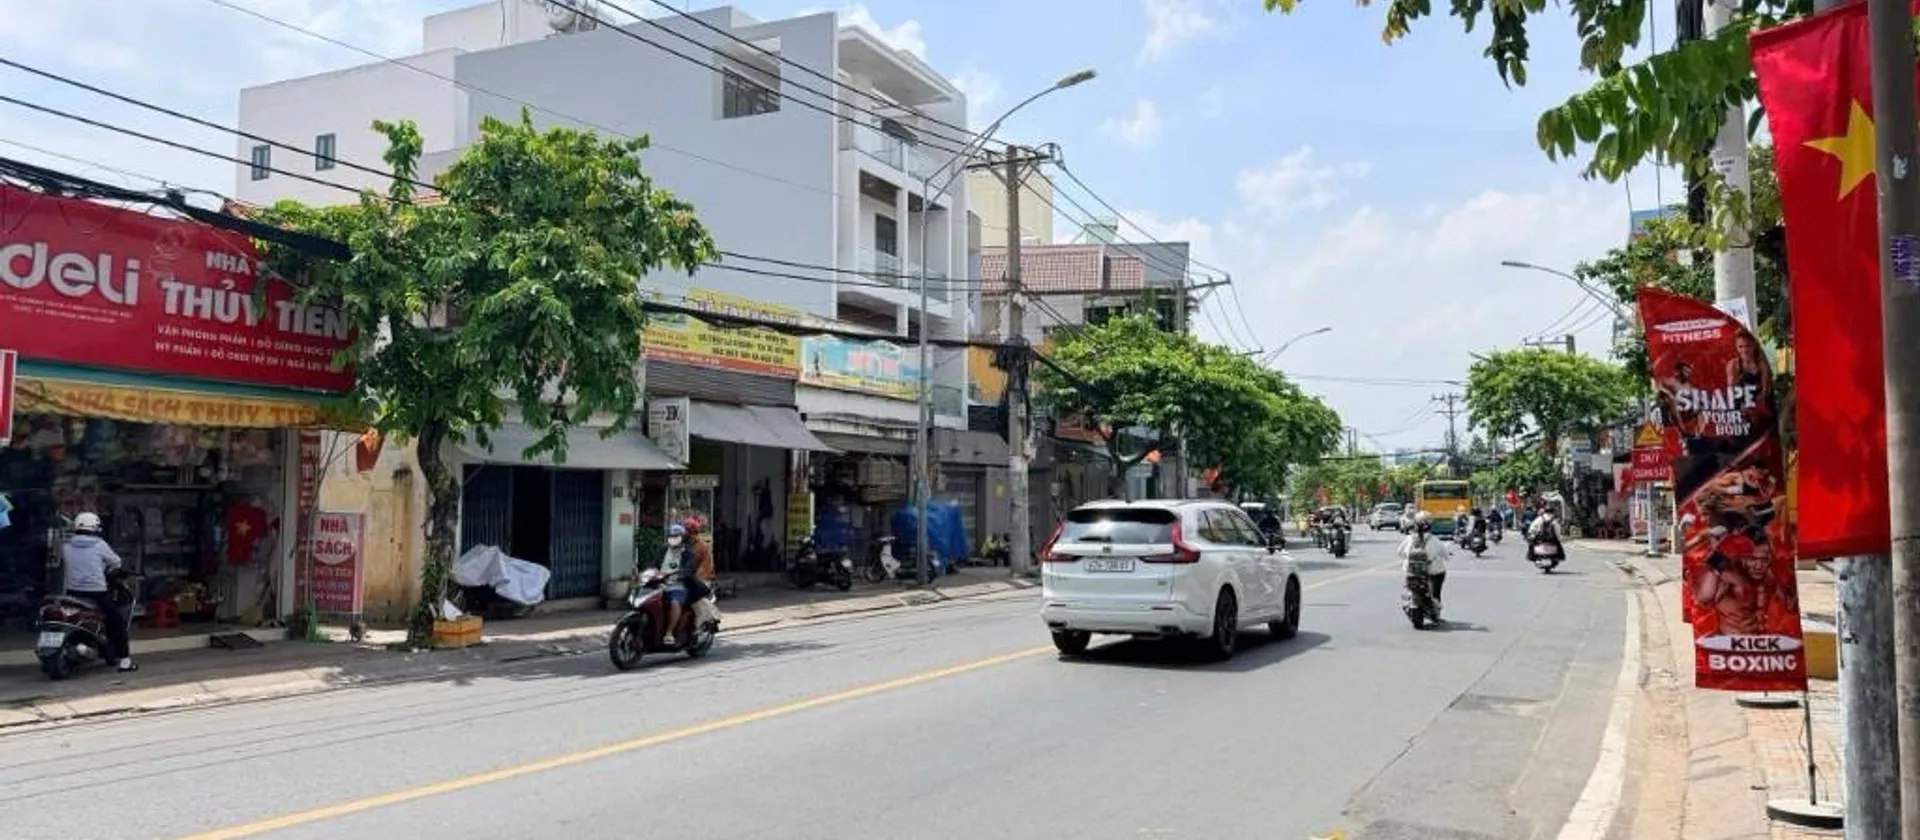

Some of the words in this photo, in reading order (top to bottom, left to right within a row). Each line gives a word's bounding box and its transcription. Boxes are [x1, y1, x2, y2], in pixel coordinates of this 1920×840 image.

[205, 251, 250, 275] NHÀ
[0, 241, 140, 305] deli
[1662, 328, 1722, 343] FITNESS
[1675, 385, 1757, 412] SHAPE
[1702, 410, 1742, 424] YOUR
[1715, 422, 1751, 437] BODY
[1730, 637, 1781, 650] KICK
[1708, 653, 1797, 672] BOXING
